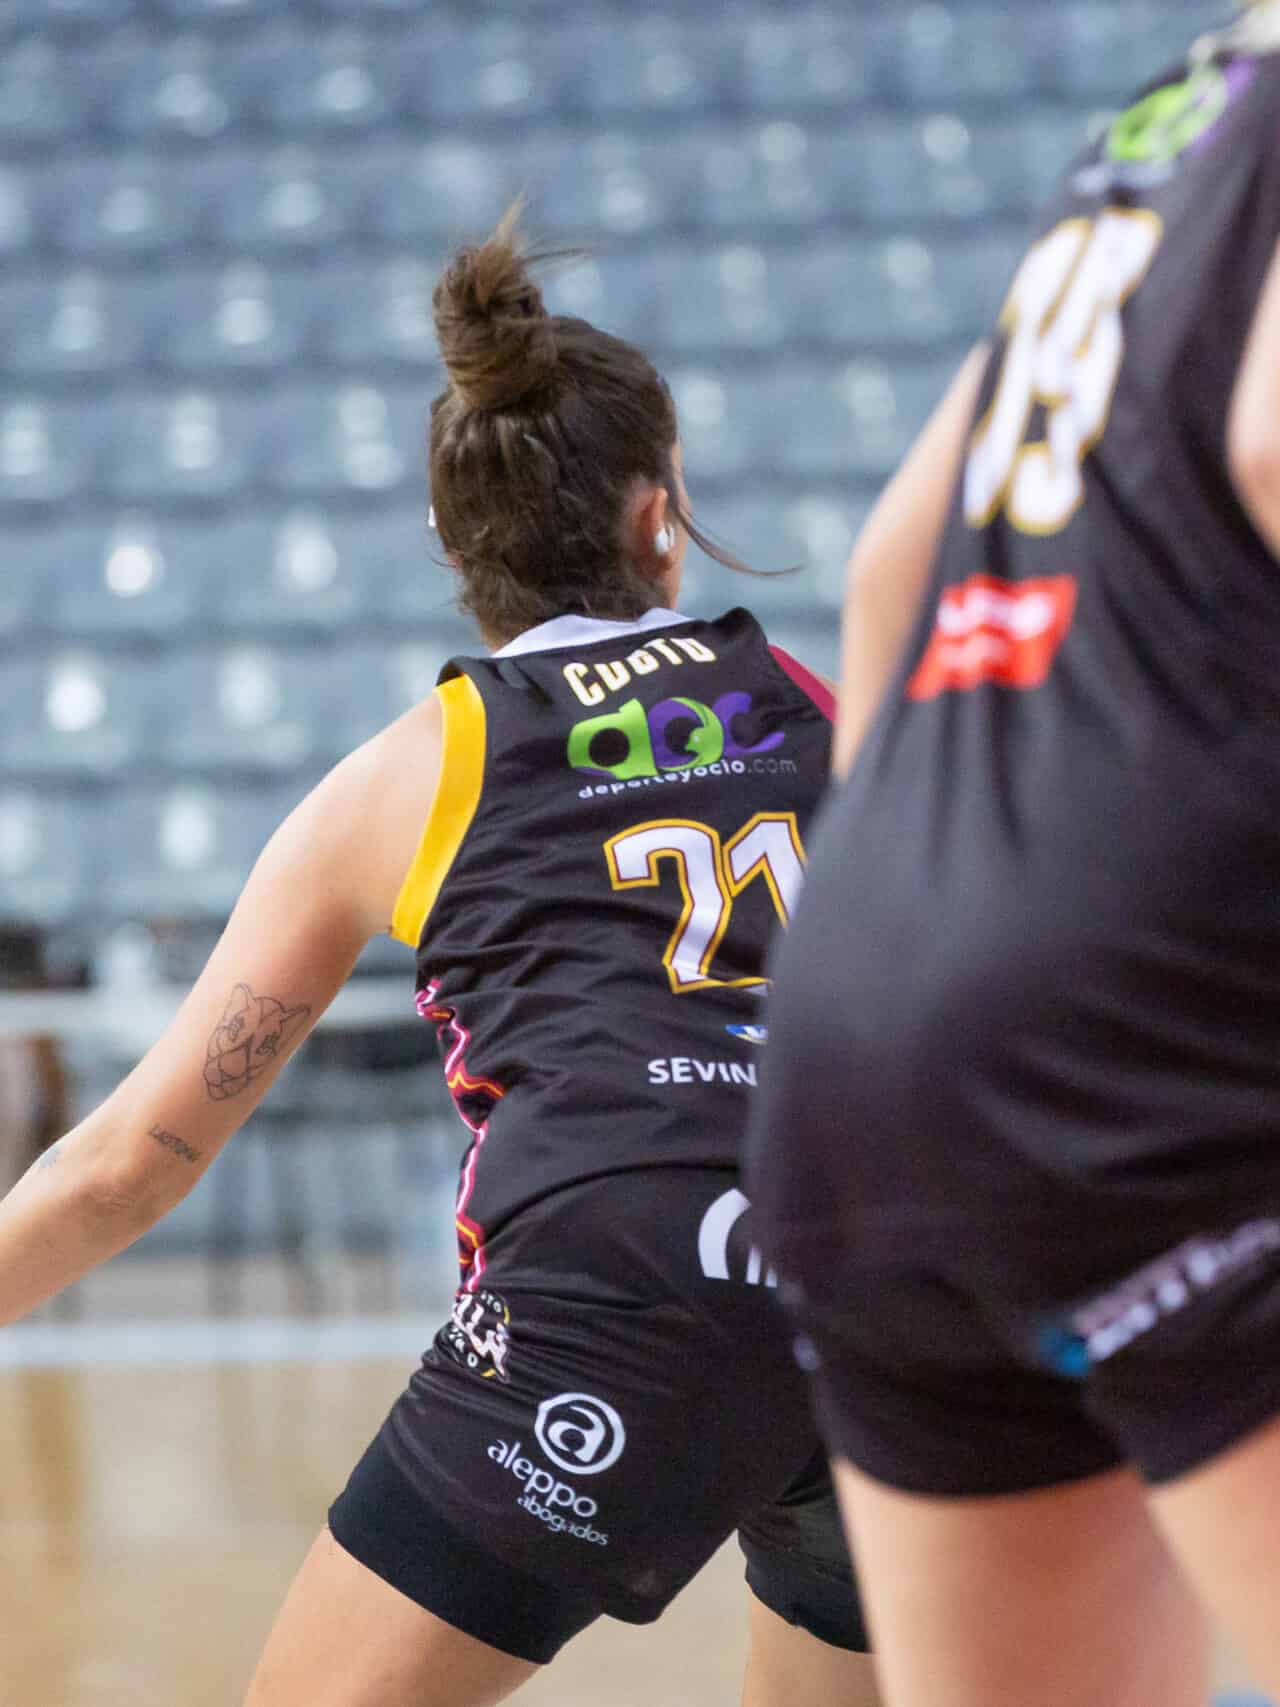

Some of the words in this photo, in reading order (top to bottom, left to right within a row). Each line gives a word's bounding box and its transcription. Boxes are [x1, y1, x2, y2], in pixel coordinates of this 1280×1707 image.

[578, 758, 798, 799] deporteyocio.com
[603, 811, 808, 994] 21
[487, 1438, 598, 1519] aleppo
[516, 1494, 609, 1547] abogados
